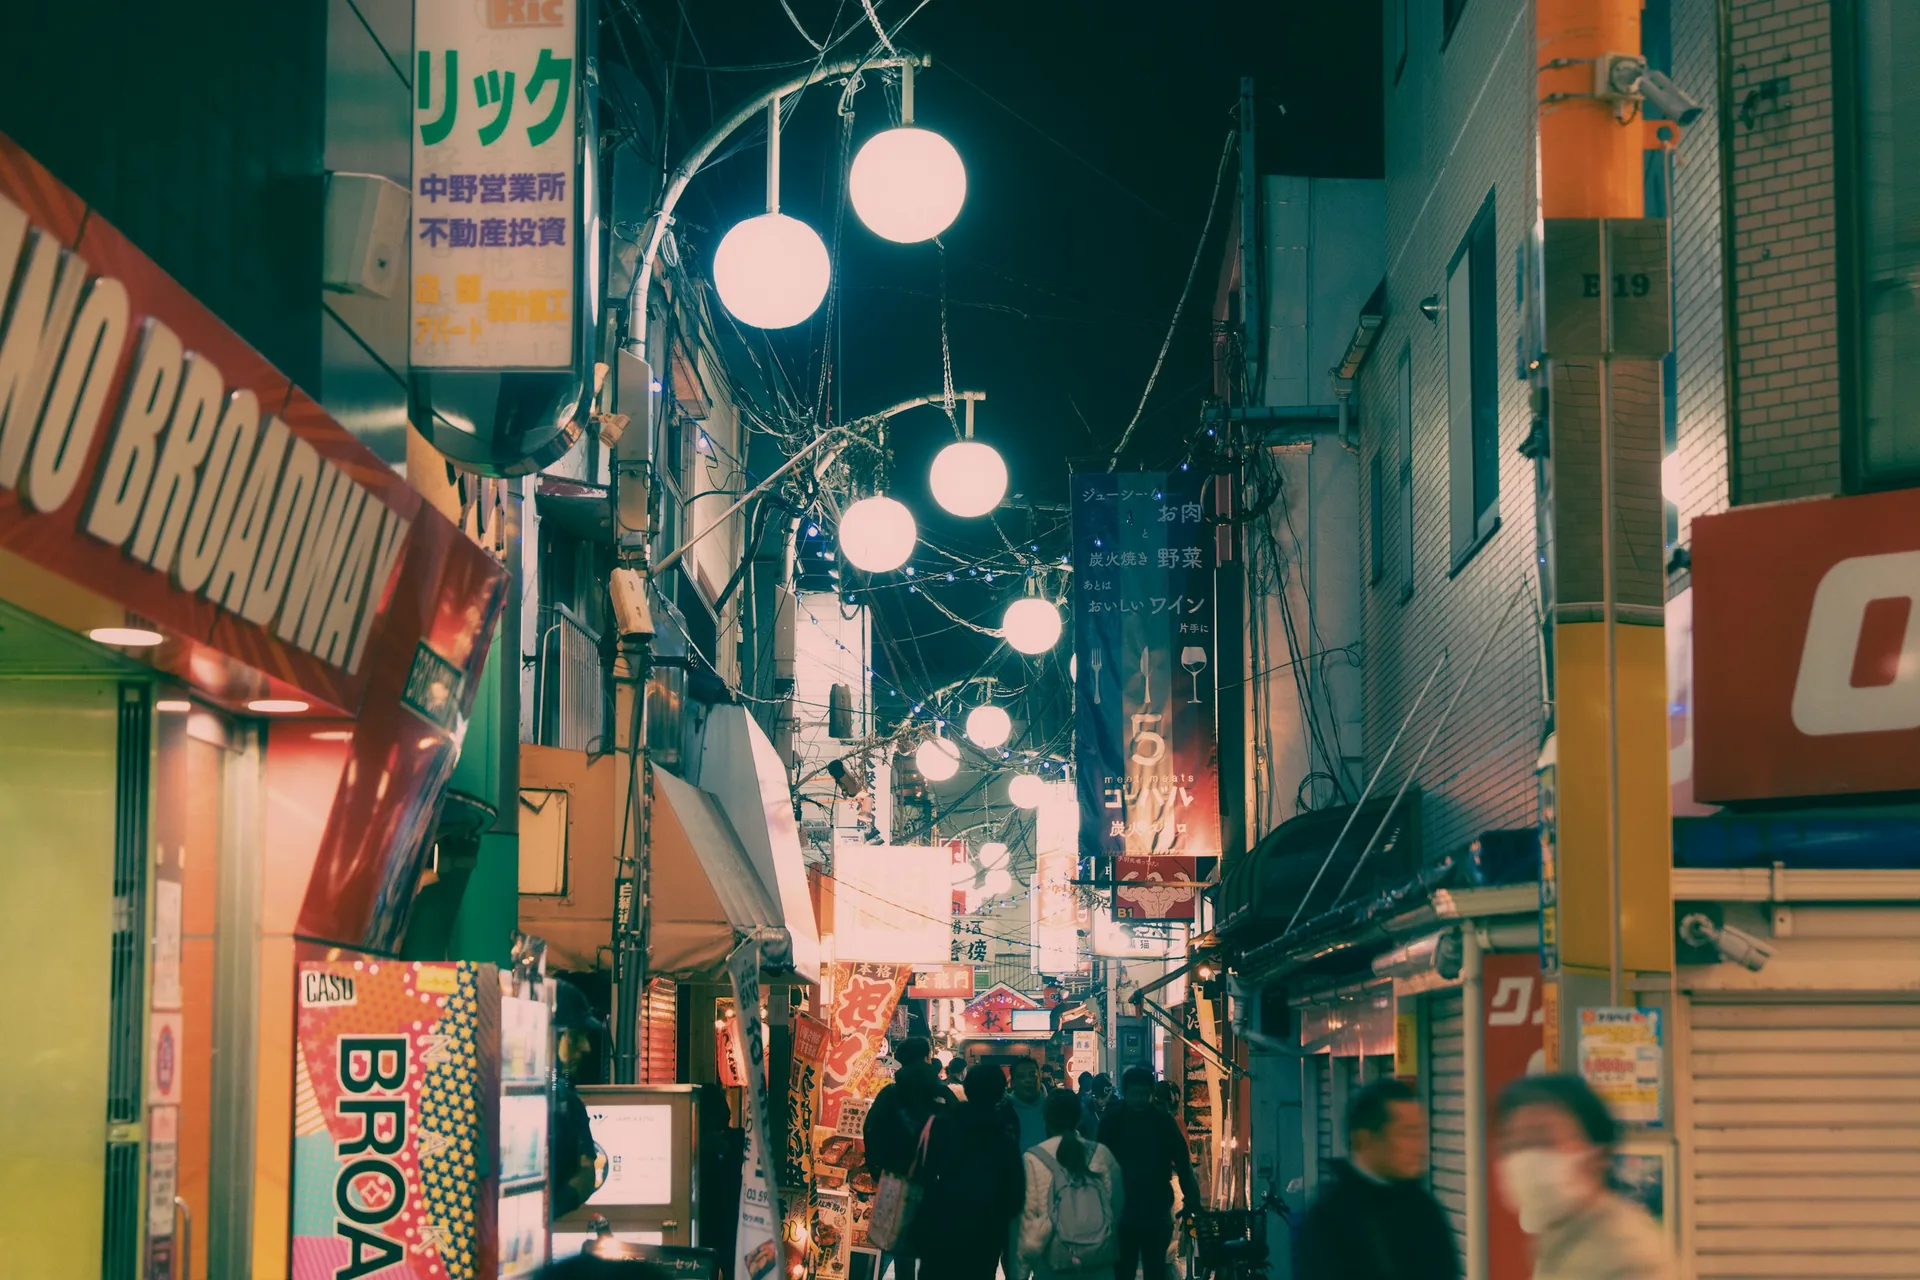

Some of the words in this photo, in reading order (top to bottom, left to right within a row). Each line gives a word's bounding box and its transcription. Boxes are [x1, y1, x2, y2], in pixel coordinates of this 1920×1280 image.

[417, 48, 573, 147] リック
[418, 171, 567, 203] 中野営業所
[418, 216, 567, 248] 不動産投資
[1612, 273, 1650, 297] 19
[86, 316, 411, 676] BROADWAY
[1157, 501, 1202, 524] お肉
[1142, 528, 1149, 539] と
[1089, 551, 1149, 568] 炭火焼き
[1157, 546, 1203, 569] 野菜
[1083, 580, 1112, 591] あとは
[1088, 599, 1145, 613] おいしい
[1149, 594, 1205, 615] ワイン
[1179, 623, 1209, 634] 片手に
[1131, 713, 1165, 766] 5
[1149, 773, 1194, 783] meats
[1117, 907, 1134, 918] B1
[857, 963, 893, 979] 本格
